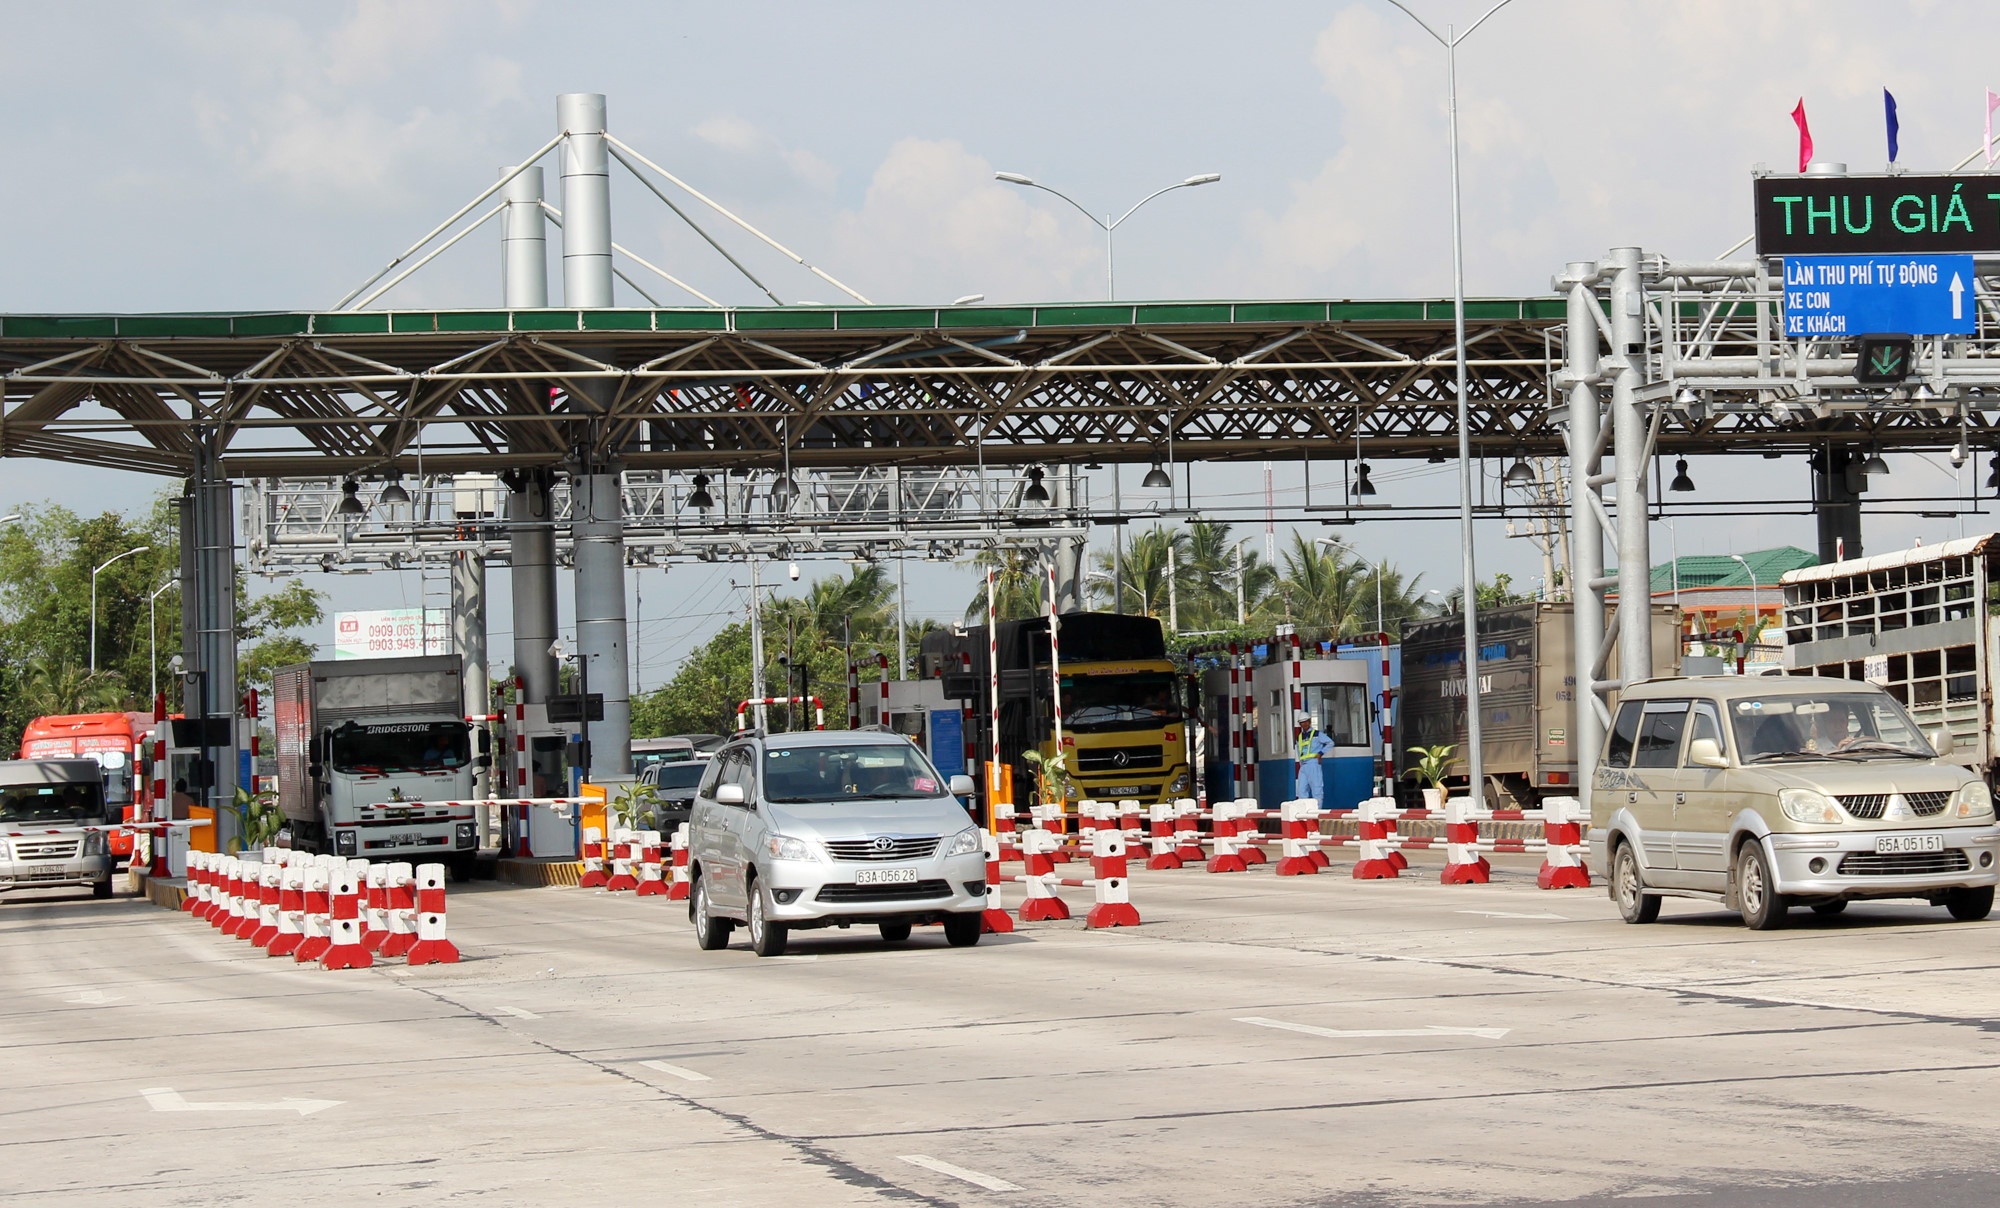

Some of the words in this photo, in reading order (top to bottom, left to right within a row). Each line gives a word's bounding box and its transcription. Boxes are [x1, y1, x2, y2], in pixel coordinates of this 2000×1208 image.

[1773, 195, 1872, 235] THU
[1891, 183, 1974, 233] GIÁ
[1787, 261, 1814, 285] LÀN
[1818, 265, 1845, 285] THU
[1850, 260, 1874, 285] PHÍ
[1877, 264, 1896, 287] TỰ
[1899, 261, 1938, 287] ĐỘNG
[1788, 292, 1803, 309] XE
[1806, 291, 1830, 309] CON
[1789, 315, 1804, 333] XE
[1807, 312, 1846, 333] KHÁCH
[1478, 675, 1492, 694] AI
[367, 724, 430, 734] BRIDGESTONE
